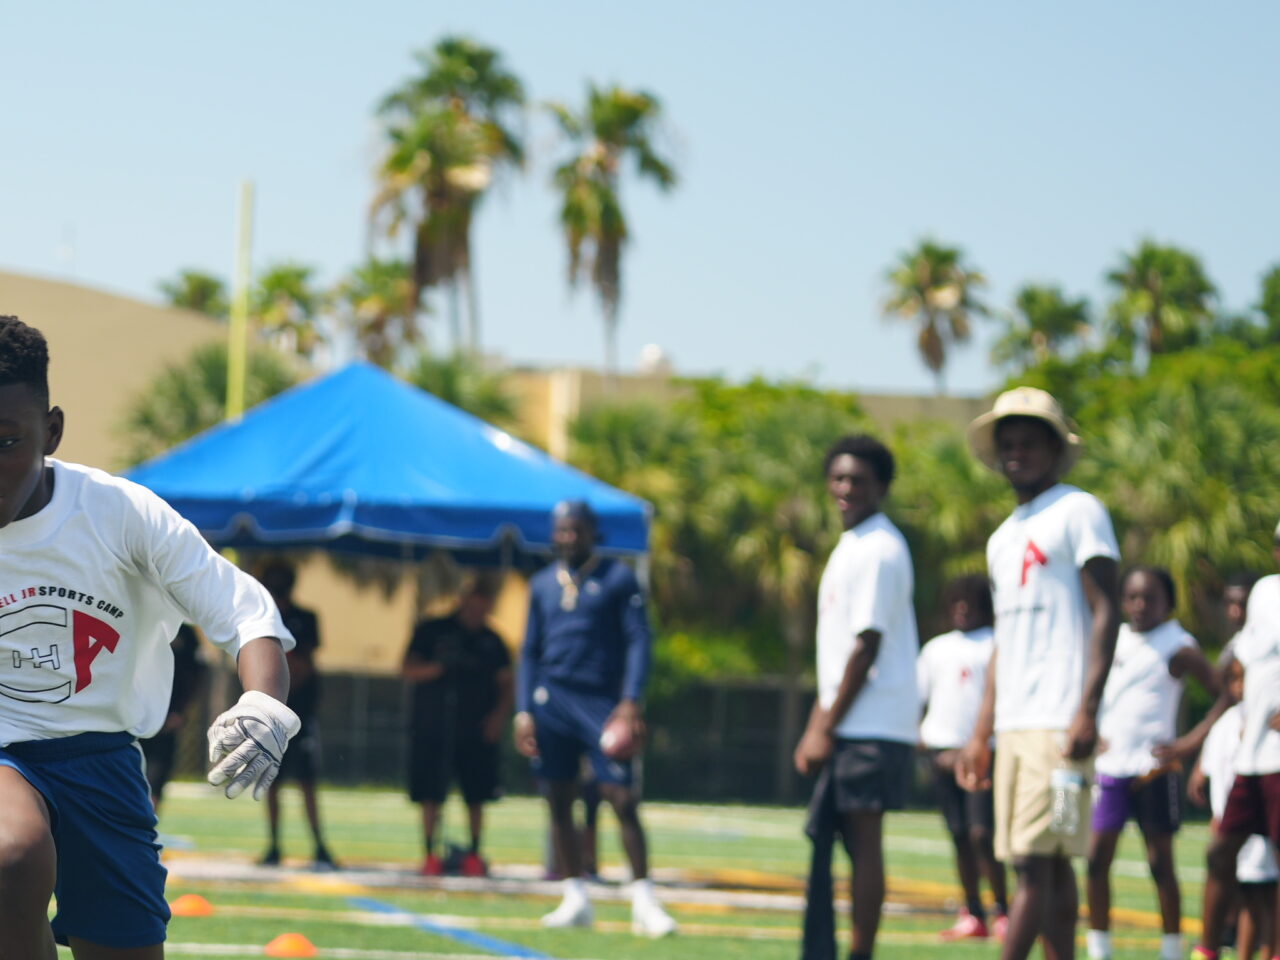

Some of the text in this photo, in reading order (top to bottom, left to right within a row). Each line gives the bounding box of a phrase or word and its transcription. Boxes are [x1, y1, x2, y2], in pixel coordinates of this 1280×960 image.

[21, 587, 37, 600] JR
[38, 586, 95, 607] SPORTS
[96, 599, 125, 620] CAMP
